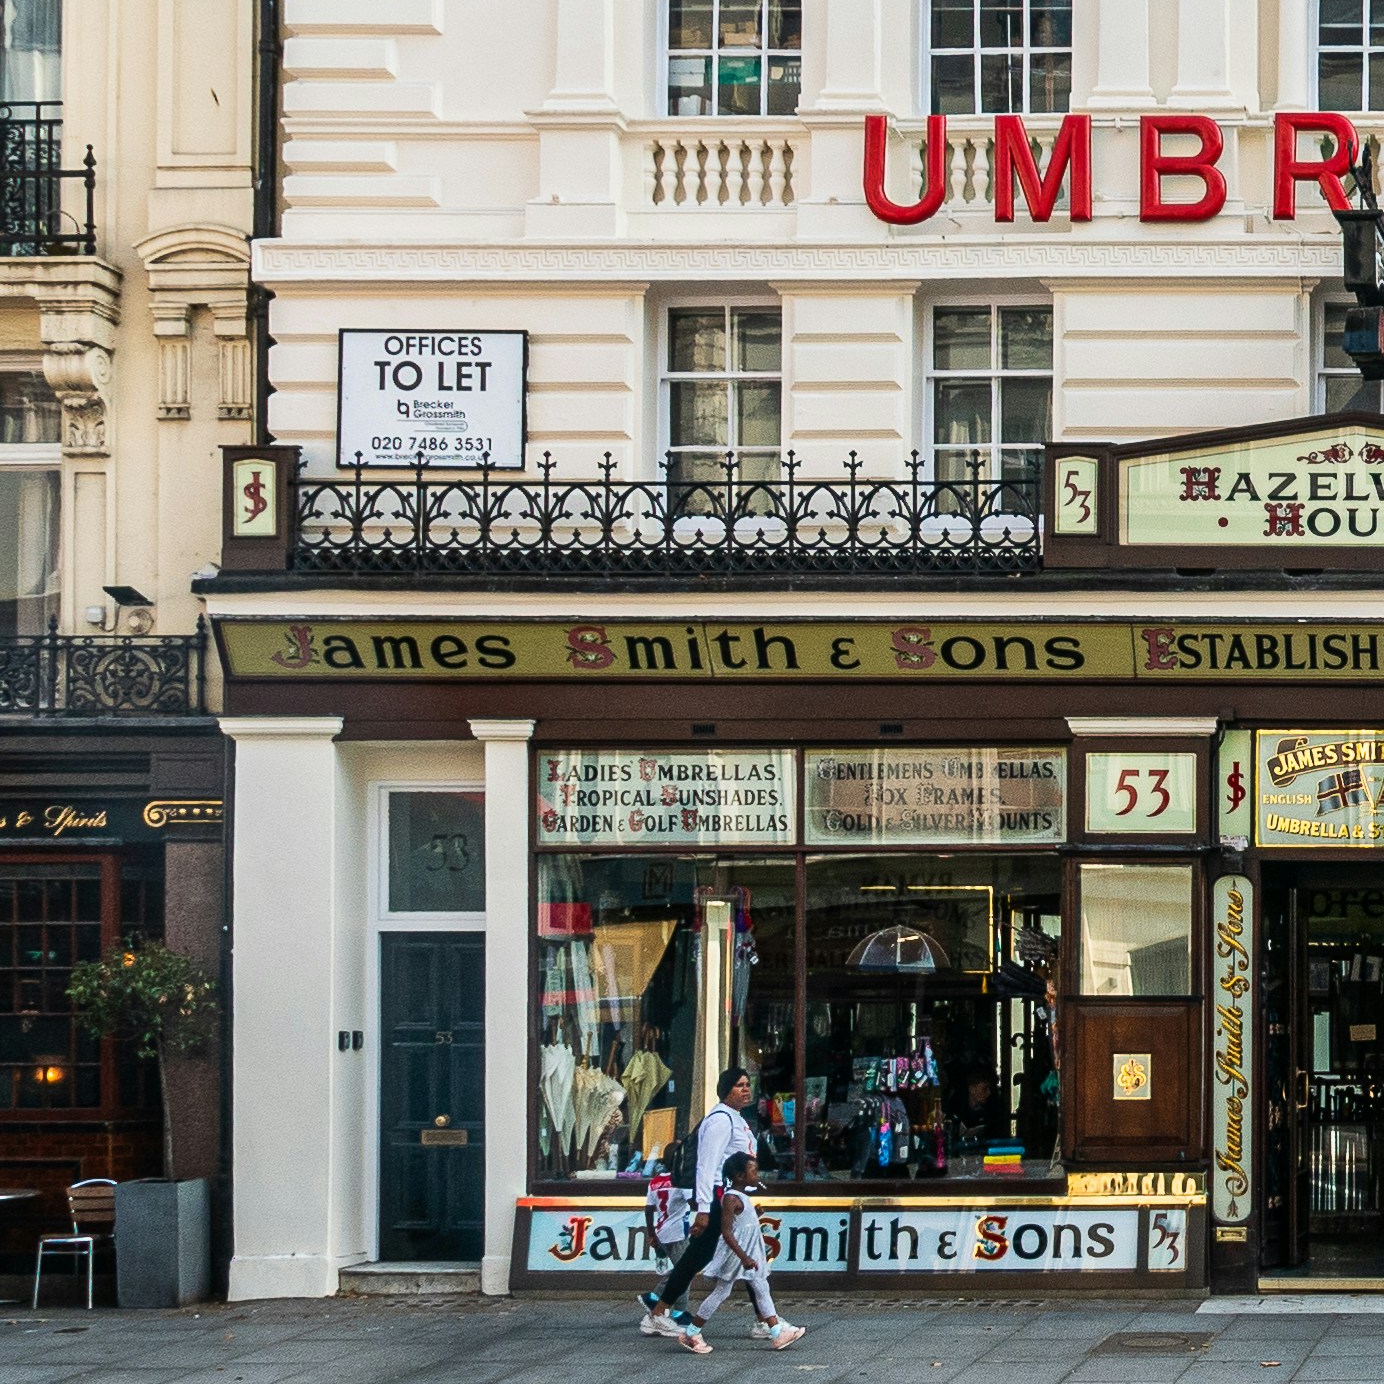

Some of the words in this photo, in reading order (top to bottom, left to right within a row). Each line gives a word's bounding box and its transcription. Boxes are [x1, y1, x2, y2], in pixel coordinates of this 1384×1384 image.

[384, 335, 482, 356] OFFICES
[374, 360, 423, 391] TO
[438, 361, 492, 391] LET
[413, 409, 466, 419] Grossmith
[372, 437, 402, 451] 020
[409, 437, 448, 451] 7486
[454, 437, 492, 451] 3531
[1063, 470, 1091, 524] 53
[271, 624, 516, 670] James
[564, 625, 800, 670] Smith
[891, 627, 1086, 671] Sons
[1273, 744, 1339, 776] JAMES
[559, 783, 656, 807] TROPICAL
[864, 782, 908, 807] FOX
[1113, 768, 1172, 817] 53
[1262, 794, 1312, 805] ENGLISH
[44, 805, 107, 836] Spirits
[541, 808, 613, 834] GARDEN
[628, 808, 678, 833] GOLF
[824, 808, 880, 832] GOLD
[899, 808, 966, 832] SILVER
[1266, 813, 1350, 839] UMBRELLA
[1352, 824, 1365, 839] &
[1215, 889, 1249, 971] Sons
[1218, 966, 1250, 999] &
[435, 1031, 454, 1046] 53
[1213, 1005, 1249, 1099] Smith
[1213, 1095, 1249, 1198] James
[973, 1214, 1115, 1261] Sons
[1152, 1214, 1179, 1265] 53
